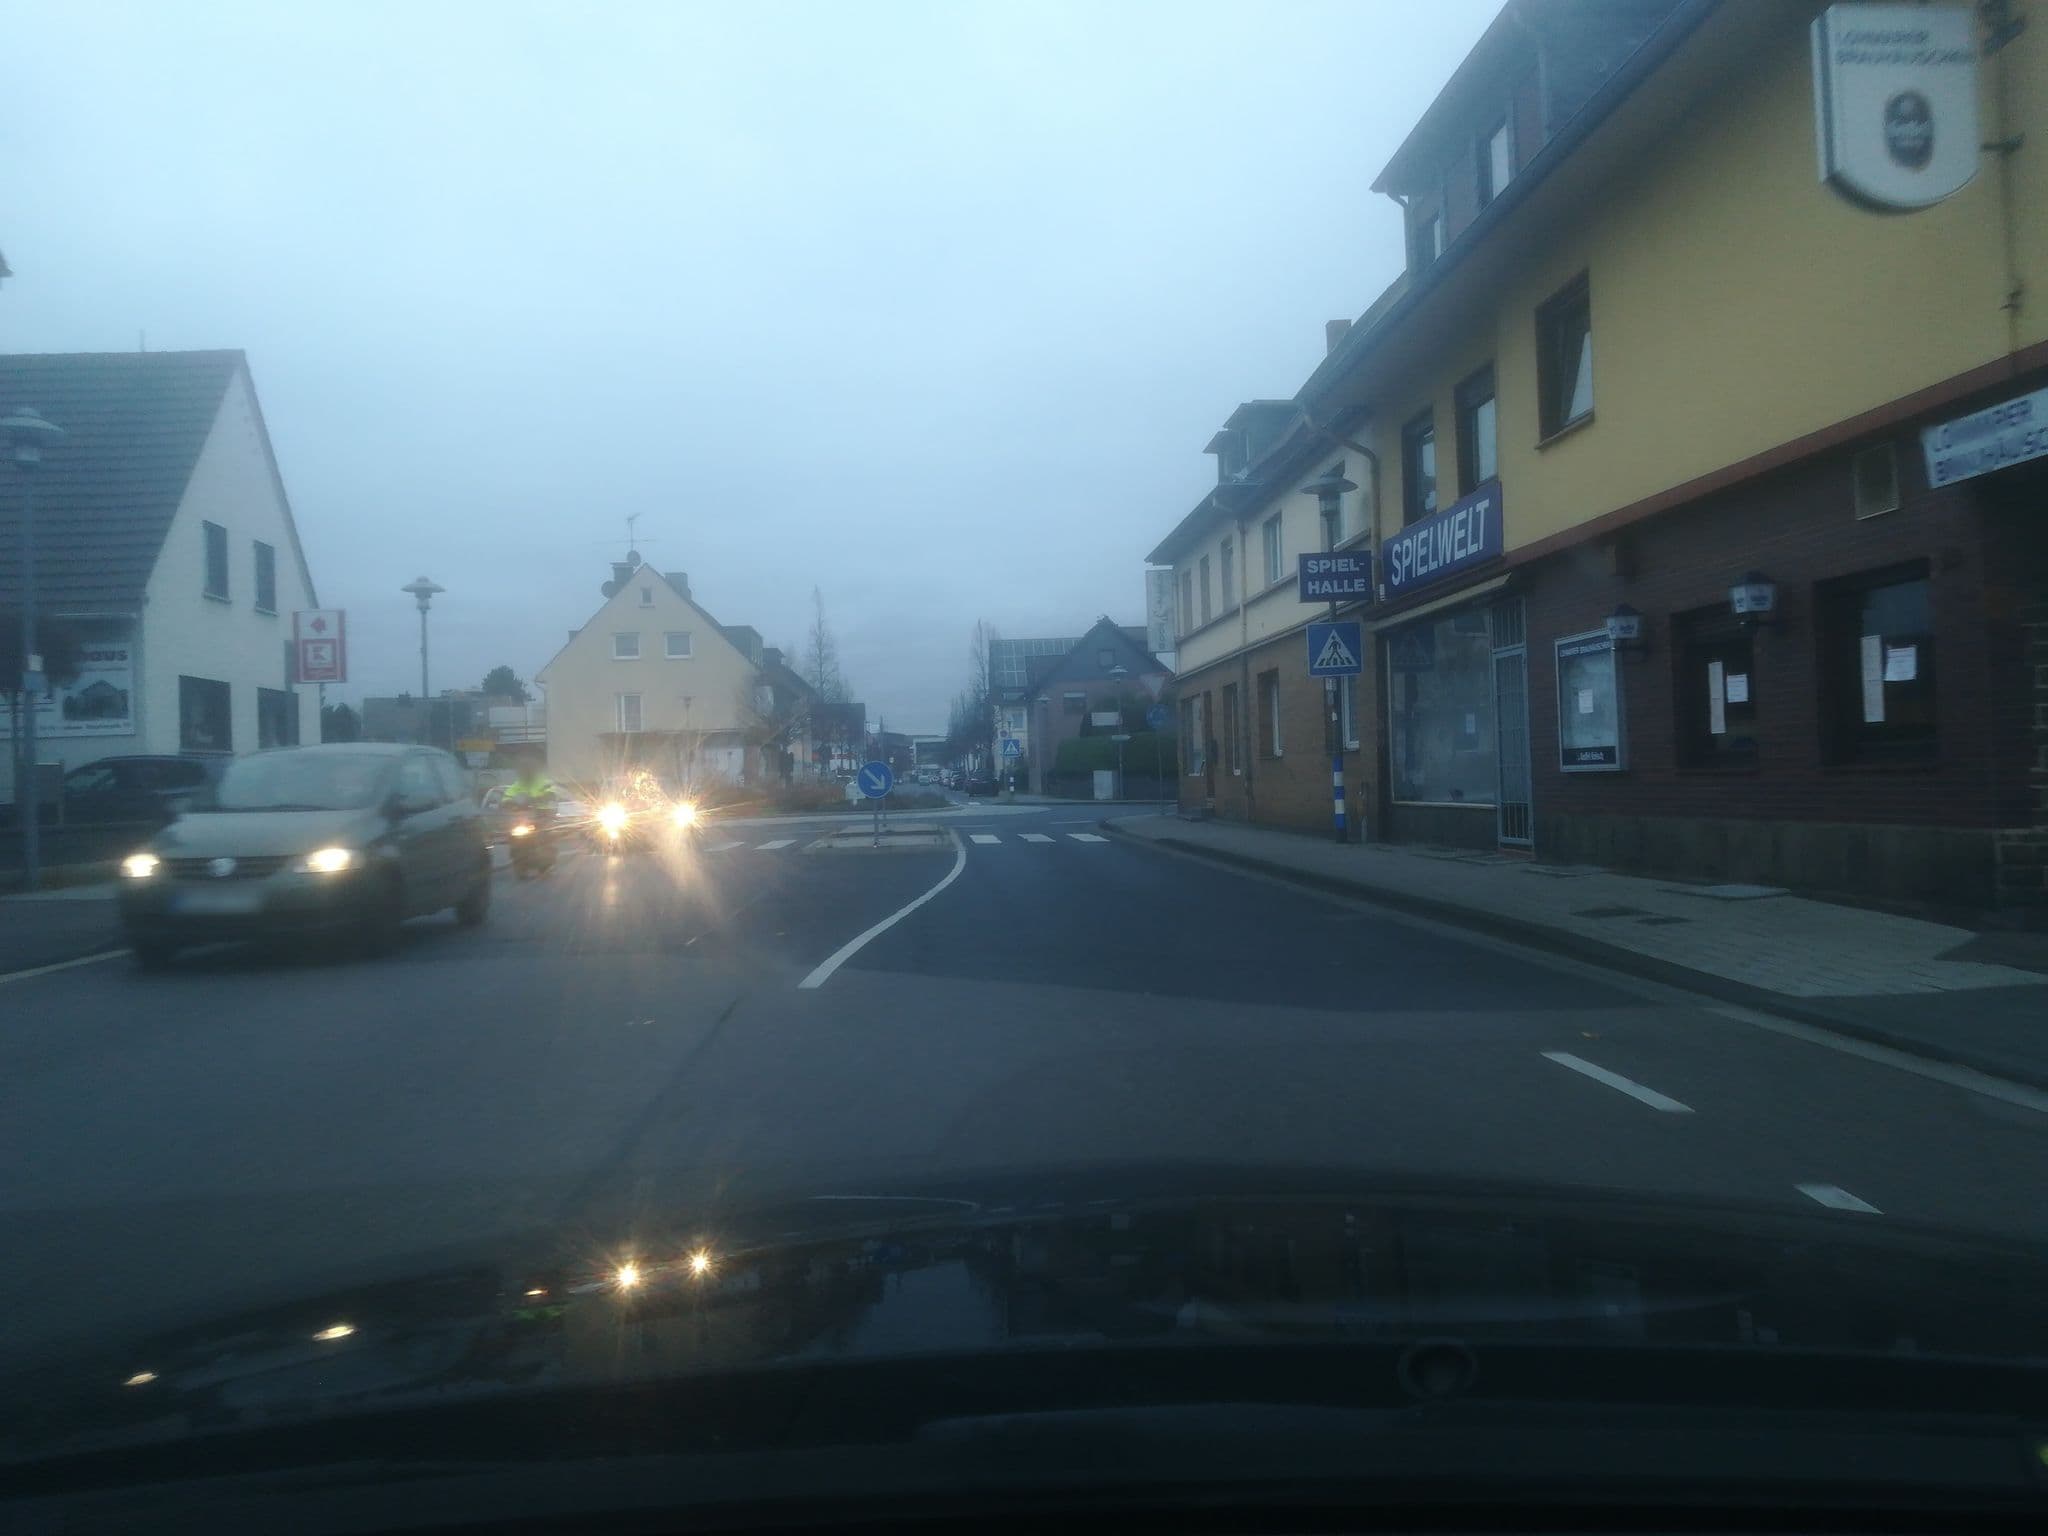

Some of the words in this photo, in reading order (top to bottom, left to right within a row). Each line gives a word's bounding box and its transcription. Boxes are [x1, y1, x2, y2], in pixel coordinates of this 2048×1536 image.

[1391, 498, 1490, 586] SPIELWELT
[1306, 557, 1365, 574] SPIEL-
[1307, 577, 1366, 595] HALLE
